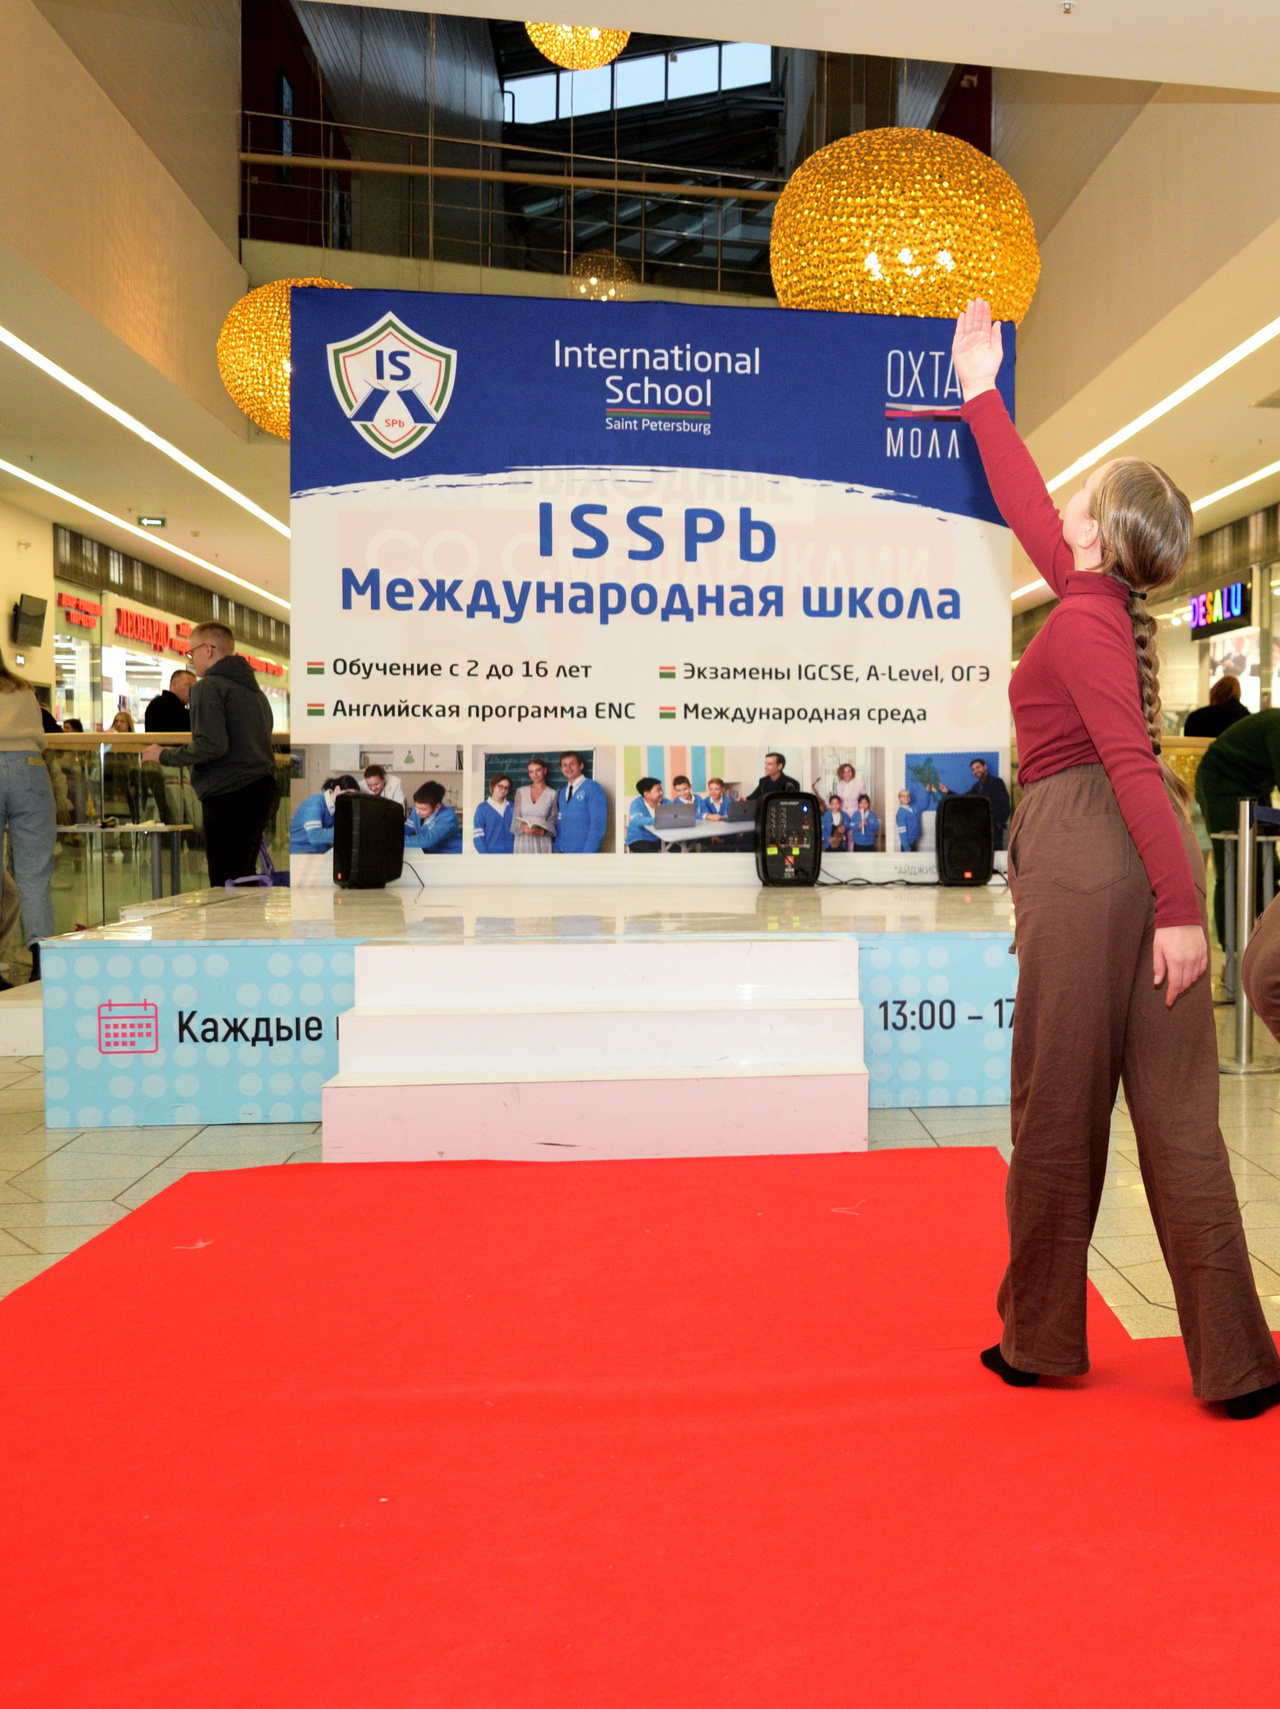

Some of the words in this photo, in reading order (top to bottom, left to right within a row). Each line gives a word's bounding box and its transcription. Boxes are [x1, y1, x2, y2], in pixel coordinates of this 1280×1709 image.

[375, 349, 412, 382] IS
[555, 340, 761, 376] International
[887, 349, 962, 399] ОХТА
[605, 376, 713, 408] School
[384, 418, 406, 429] SPb
[605, 417, 639, 433] Saint
[642, 419, 712, 436] Petersburg
[886, 426, 961, 459] МОЛЛ
[540, 503, 777, 564] ISSPb
[342, 568, 785, 626] Международная
[802, 587, 963, 621] школа
[1189, 582, 1243, 630] DESALU
[115, 607, 171, 653] ЛЕОНАРДО
[332, 658, 443, 682] Обучение
[449, 664, 460, 679] с
[466, 661, 480, 678] 2
[486, 664, 515, 682] до
[522, 661, 549, 679] 16
[555, 664, 593, 680] лет
[683, 662, 792, 681] Экзамены
[797, 663, 861, 684] IGCSE,
[866, 664, 946, 684] A-Level,
[951, 664, 991, 683] ОГЭ
[332, 700, 461, 723] Английская
[466, 704, 588, 723] программа
[594, 703, 637, 720] ENC
[682, 702, 862, 725] Международная
[867, 708, 928, 726] среда
[178, 1009, 324, 1048] Каждые
[878, 998, 956, 1031] 13:00
